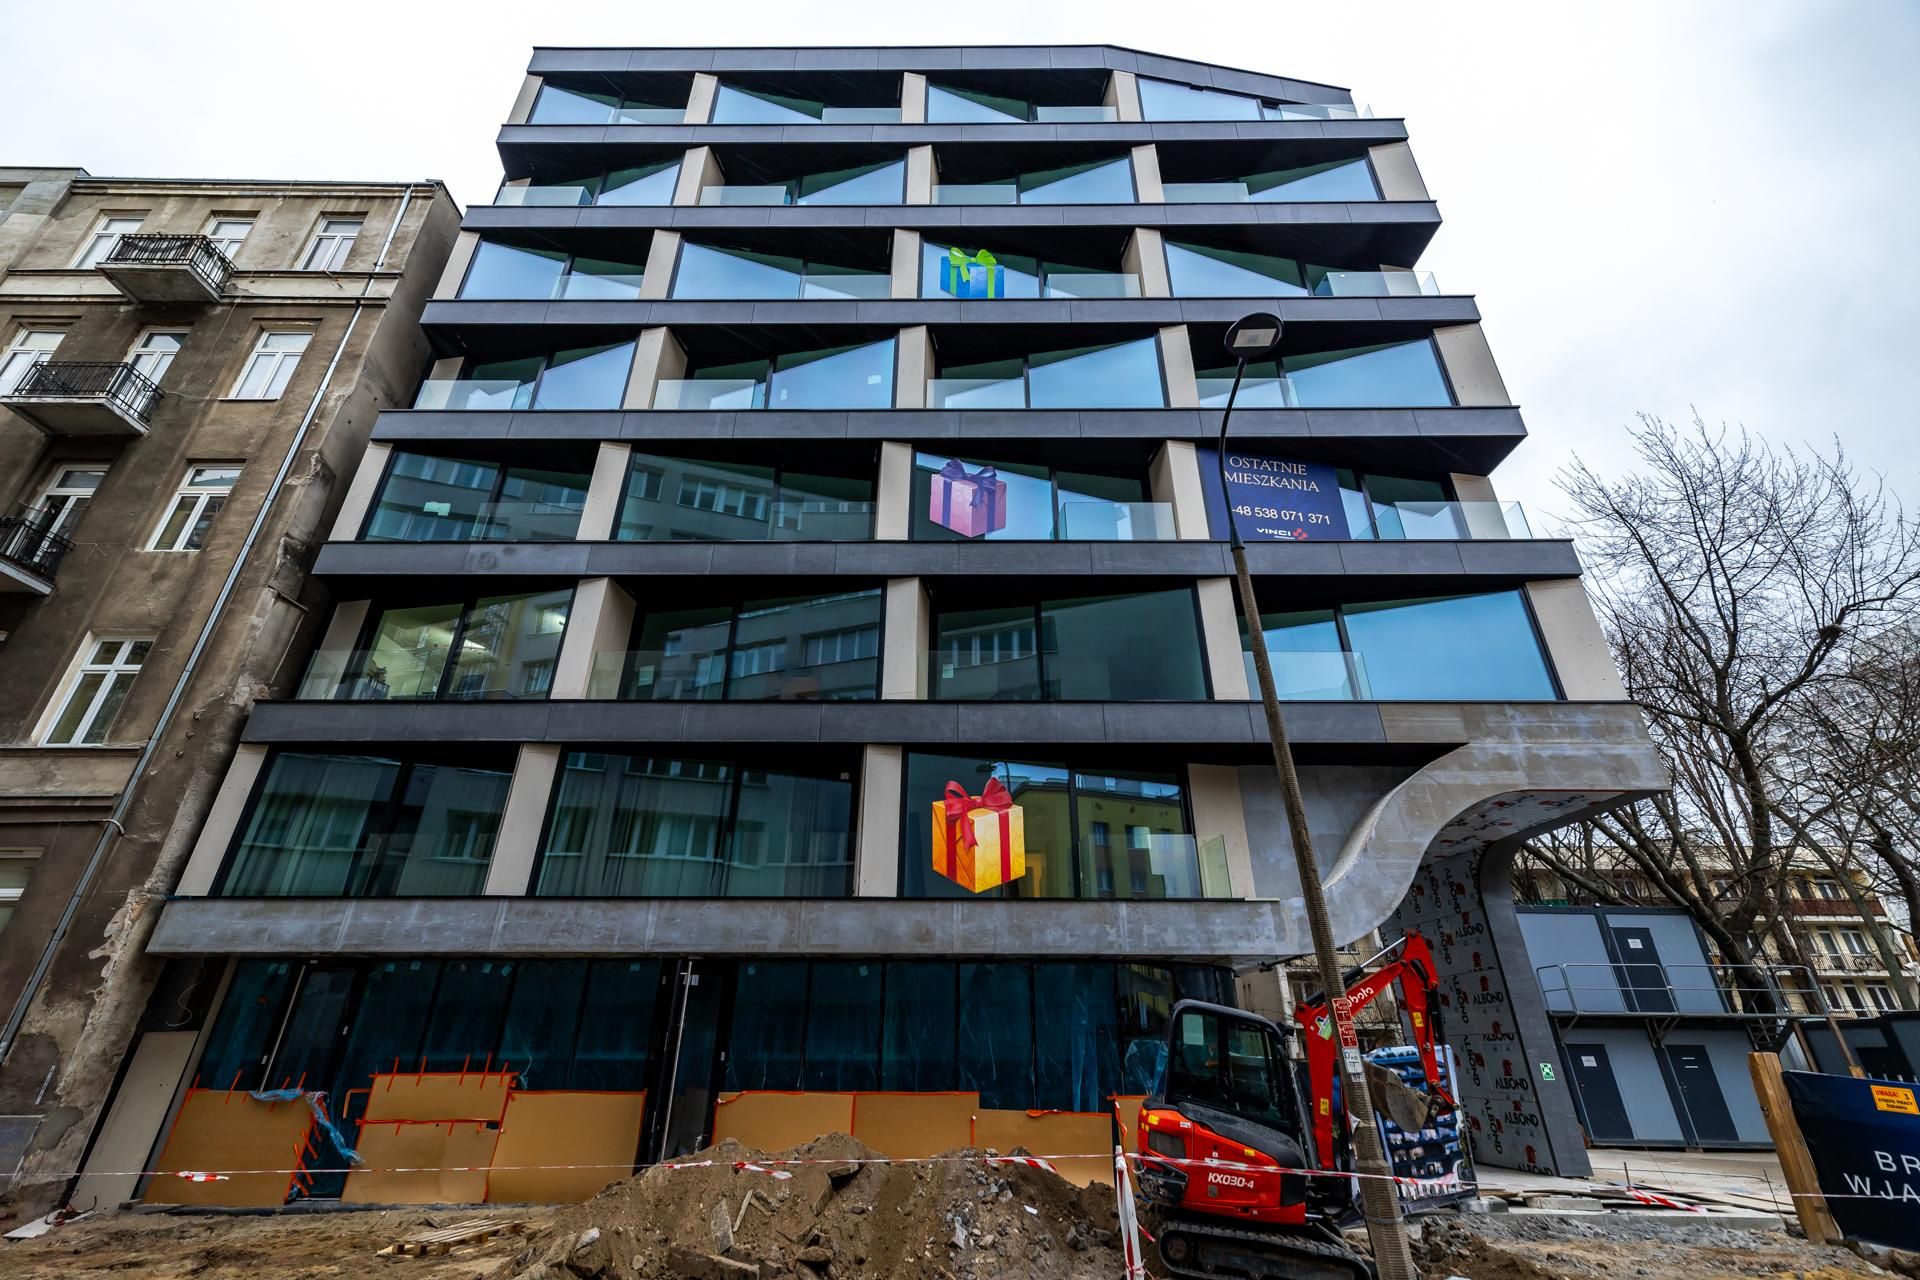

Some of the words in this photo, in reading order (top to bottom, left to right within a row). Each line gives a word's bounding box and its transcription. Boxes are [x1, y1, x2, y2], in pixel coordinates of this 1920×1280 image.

[1229, 456, 1307, 476] OSTATNIE
[1224, 470, 1320, 493] MIESZKANIA
[1254, 507, 1279, 519] 538
[1281, 510, 1304, 523] 071
[1308, 513, 1331, 525] 371
[1256, 527, 1292, 537] VINCI
[1455, 923, 1484, 938] ALBOND
[1452, 975, 1469, 1024] ALBOND
[1473, 991, 1504, 1005] ALBOND
[1464, 1035, 1481, 1087] ALBOND
[1495, 1077, 1529, 1090] ALBOND
[1484, 1098, 1503, 1154] ALBOND
[1504, 1112, 1539, 1127] ALBOND
[1874, 1151, 1920, 1175] BR
[1207, 1172, 1255, 1189] KX030-4
[1843, 1172, 1920, 1204] WJA
